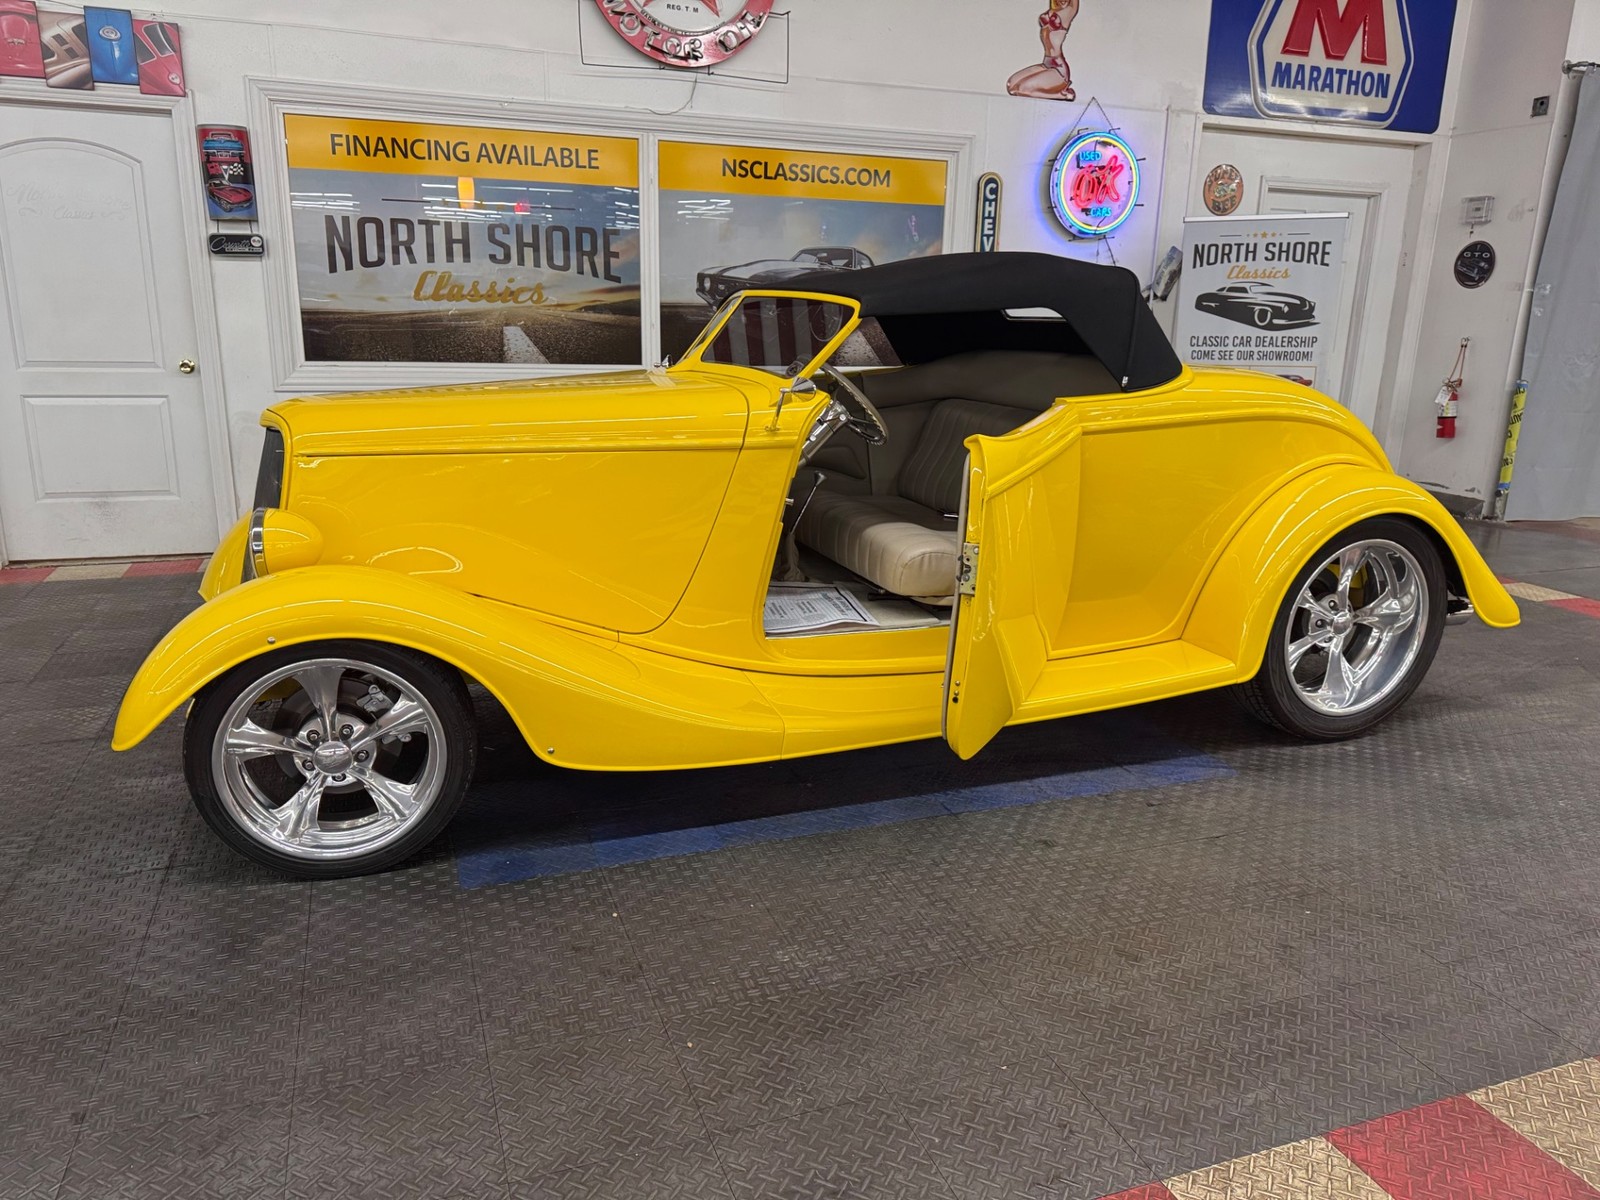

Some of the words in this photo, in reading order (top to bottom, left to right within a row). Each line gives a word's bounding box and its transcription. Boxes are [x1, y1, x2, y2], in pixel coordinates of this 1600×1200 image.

[602, 0, 704, 62] MOTOR
[716, 9, 766, 55] OIL
[1271, 61, 1391, 99] MARATHON
[329, 133, 471, 162] FINANCING
[476, 142, 600, 170] AVAILABLE
[1078, 151, 1103, 161] USED
[721, 158, 892, 188] NSCLASSICS.COM
[1070, 154, 1124, 208] OK
[1090, 207, 1112, 217] CARS
[325, 214, 471, 274] NORTH
[488, 222, 622, 284] SHORE
[1192, 242, 1257, 269] NORTH
[1264, 240, 1332, 267] SHORE
[1226, 264, 1292, 280] Classics
[413, 270, 549, 305] Classics
[1189, 335, 1229, 348] CLASSIC
[1232, 335, 1252, 348] CAR
[1254, 336, 1318, 349] DEALERSHIP
[1190, 349, 1216, 361] COME
[1218, 350, 1235, 361] SEE
[1236, 350, 1255, 361] OUR
[1257, 350, 1313, 362] SHOWROOM!
